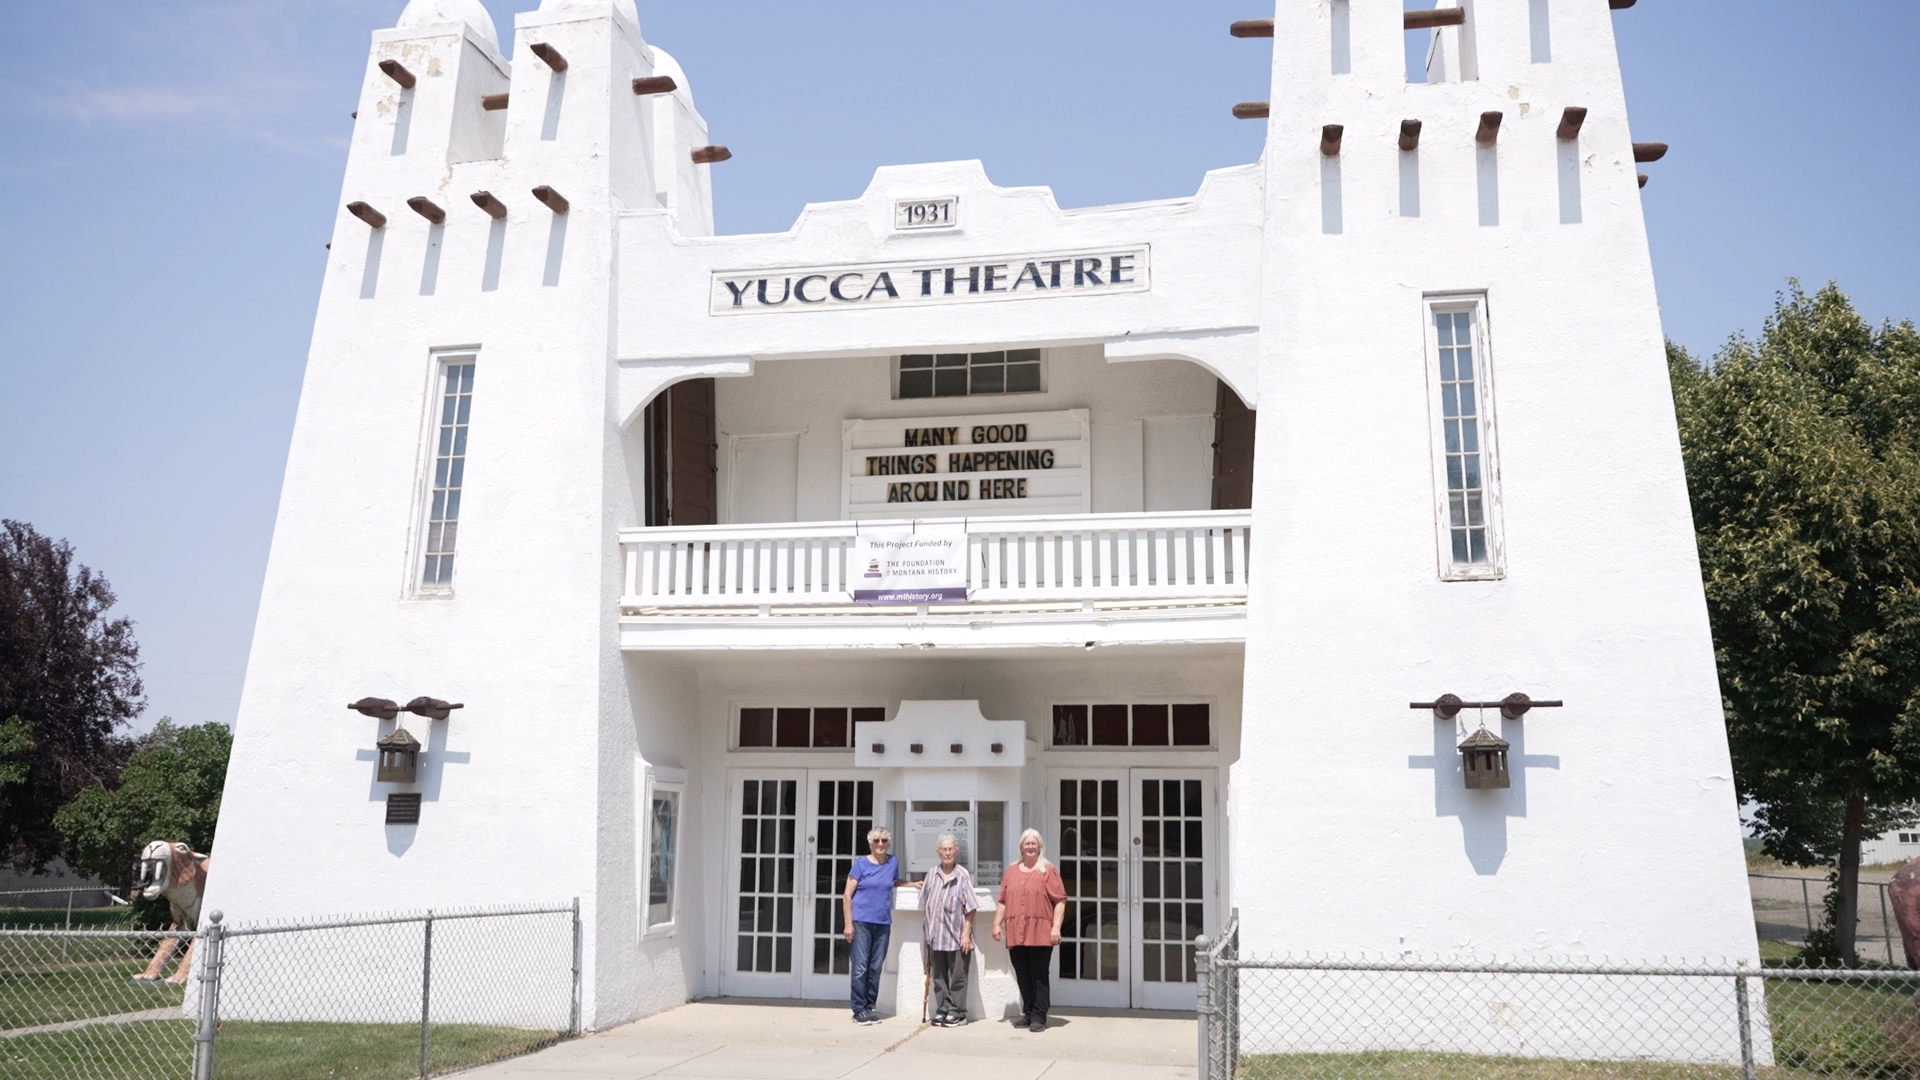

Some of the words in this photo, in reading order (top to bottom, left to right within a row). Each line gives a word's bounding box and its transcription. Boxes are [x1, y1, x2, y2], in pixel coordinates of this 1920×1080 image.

[902, 202, 950, 224] 1931
[724, 271, 900, 309] YUCCA
[912, 255, 1135, 297] THEATRE
[904, 427, 958, 447] MANY
[971, 423, 1027, 444] GOOD
[866, 454, 936, 476] THINGS
[949, 449, 1054, 473] HAPPENING
[887, 480, 970, 503] AROUND
[980, 478, 1027, 500] HERE
[870, 541, 885, 549] This
[886, 541, 913, 549] Project
[914, 540, 942, 548] Funded
[943, 539, 953, 548] by
[886, 560, 900, 568] THE
[902, 559, 945, 567] FOUNDATION
[878, 592, 943, 601] www.mthistory.org
